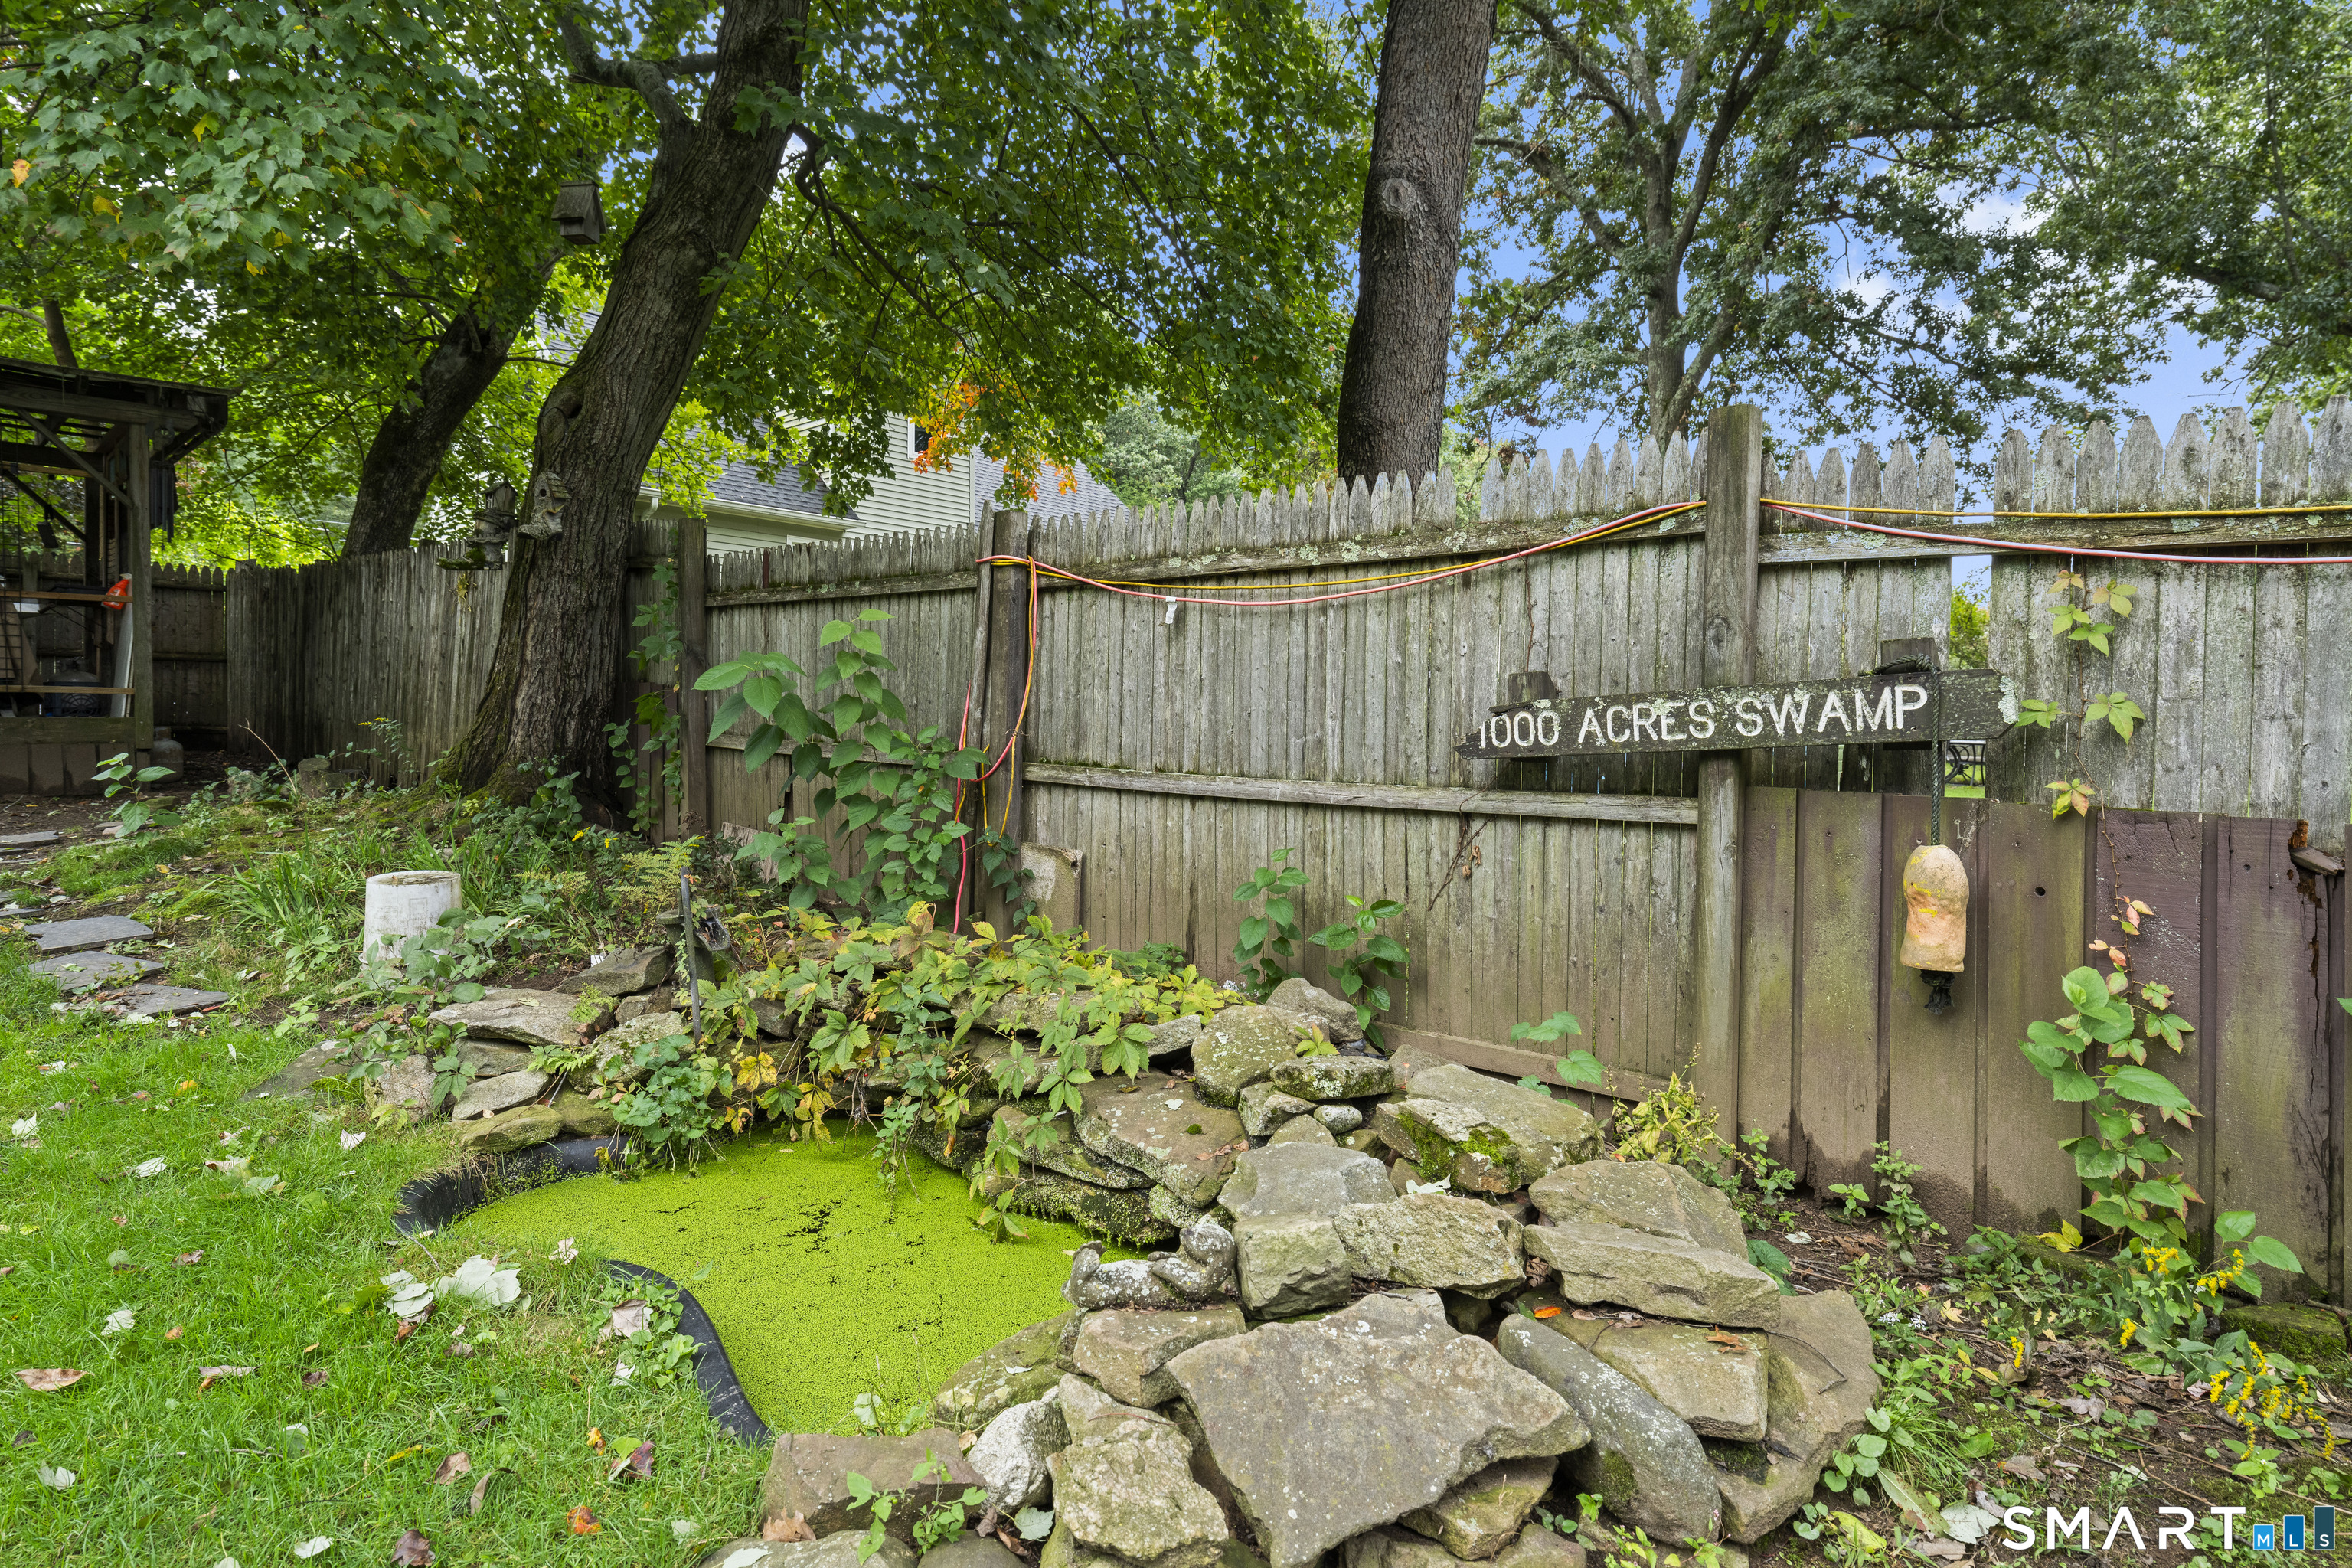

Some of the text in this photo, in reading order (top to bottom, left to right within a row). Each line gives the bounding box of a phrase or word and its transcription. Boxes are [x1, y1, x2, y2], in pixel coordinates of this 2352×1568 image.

[1479, 683, 1928, 749] 1000 ACRES SWAMP
